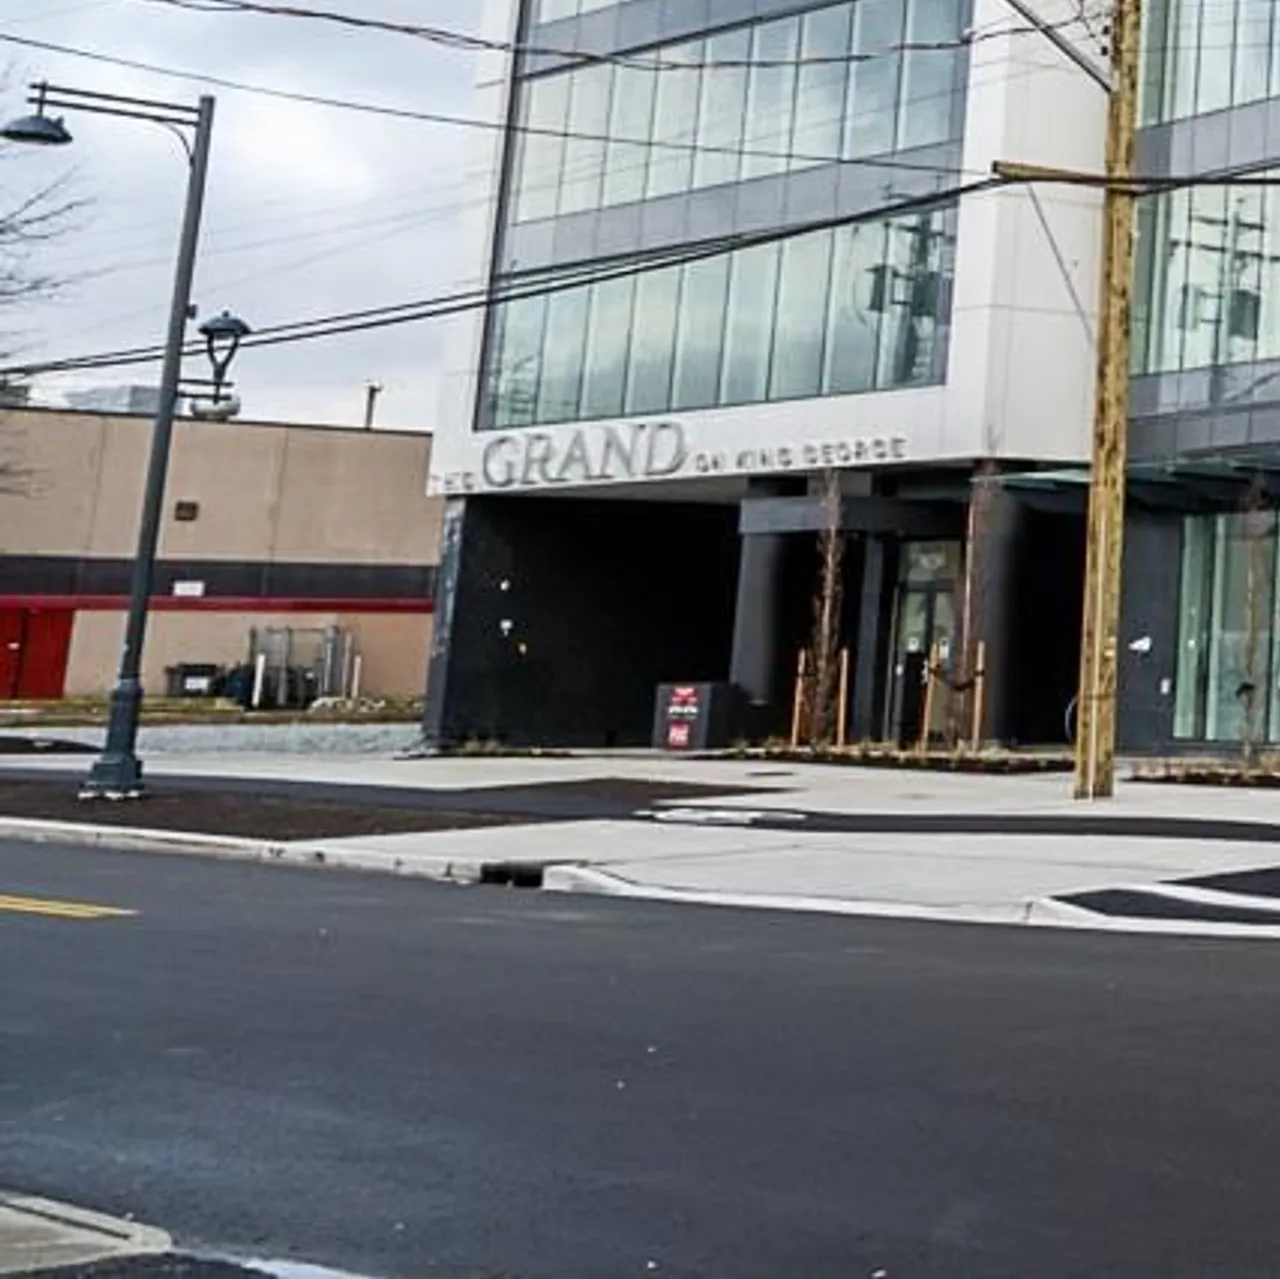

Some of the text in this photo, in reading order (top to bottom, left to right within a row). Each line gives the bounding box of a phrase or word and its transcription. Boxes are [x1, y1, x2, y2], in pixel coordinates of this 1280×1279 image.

[482, 422, 688, 488] GRAND
[736, 448, 795, 468] KING
[803, 437, 907, 465] GEORGE
